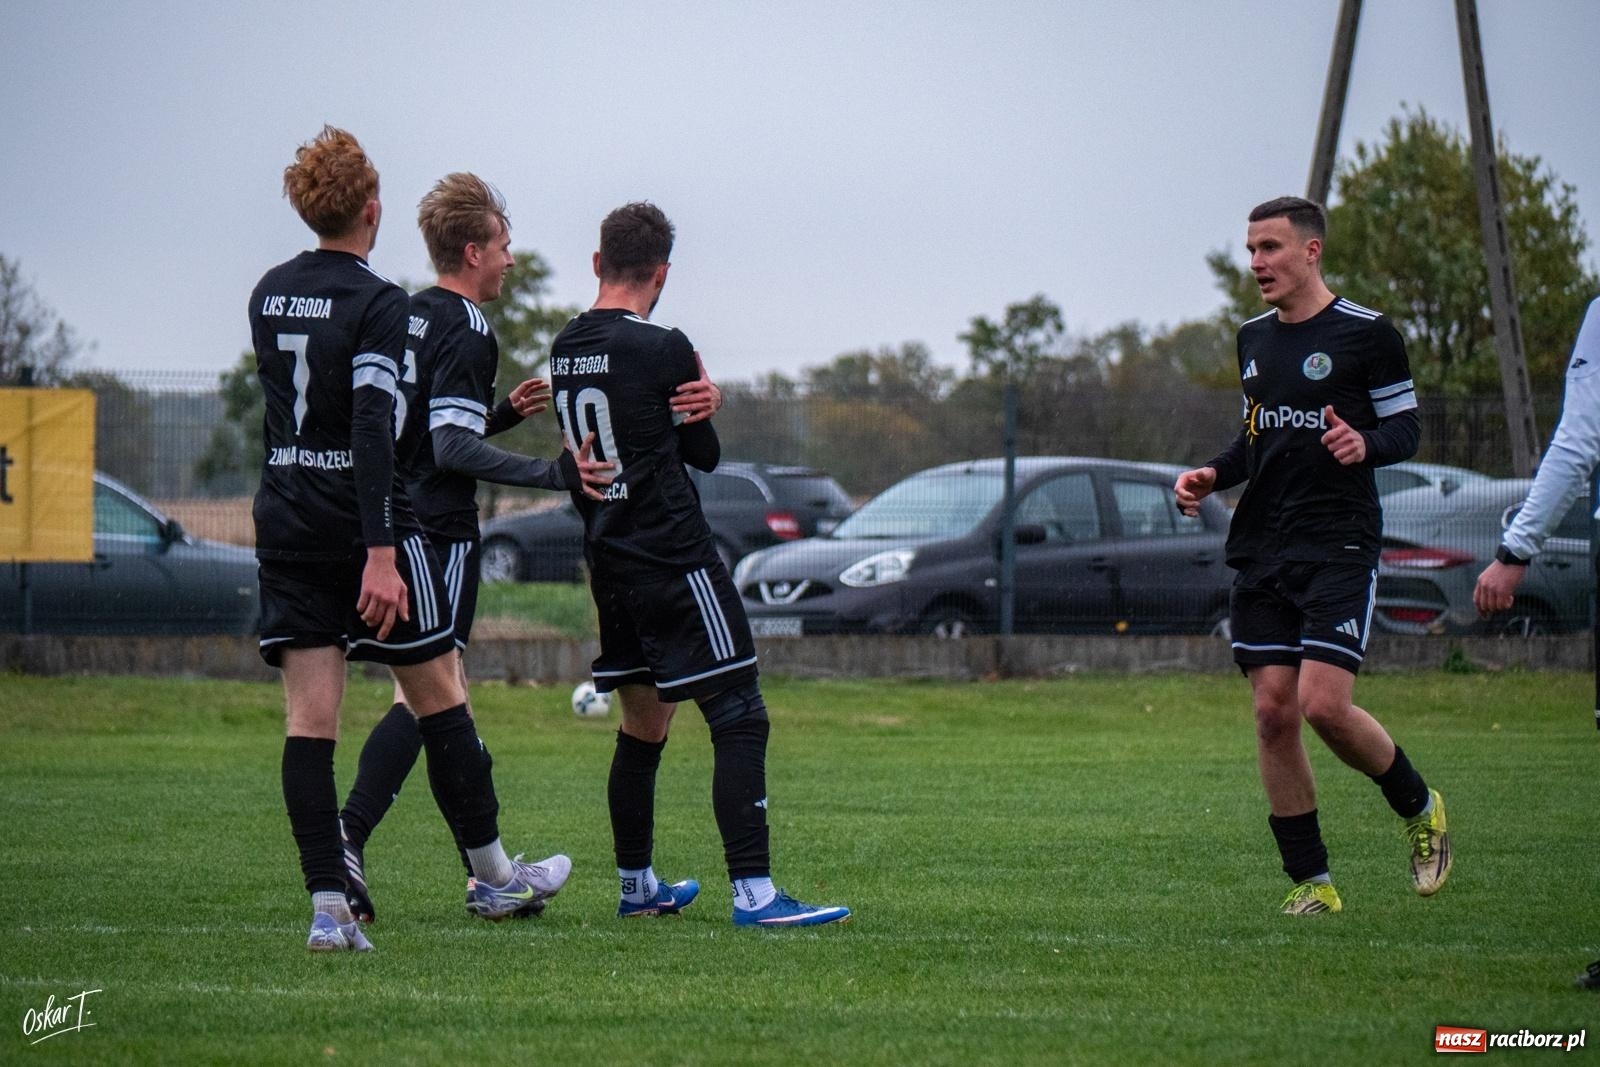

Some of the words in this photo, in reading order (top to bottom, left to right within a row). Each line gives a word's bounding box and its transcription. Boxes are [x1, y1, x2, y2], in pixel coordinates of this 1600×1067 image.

[262, 295, 286, 316] LKS
[286, 296, 333, 319] ZGODA
[277, 333, 310, 436] 7
[551, 356, 570, 376] LKS
[572, 354, 609, 375] ZGODA
[555, 387, 623, 479] 10
[1259, 405, 1328, 430] InPost
[0, 445, 14, 504] t
